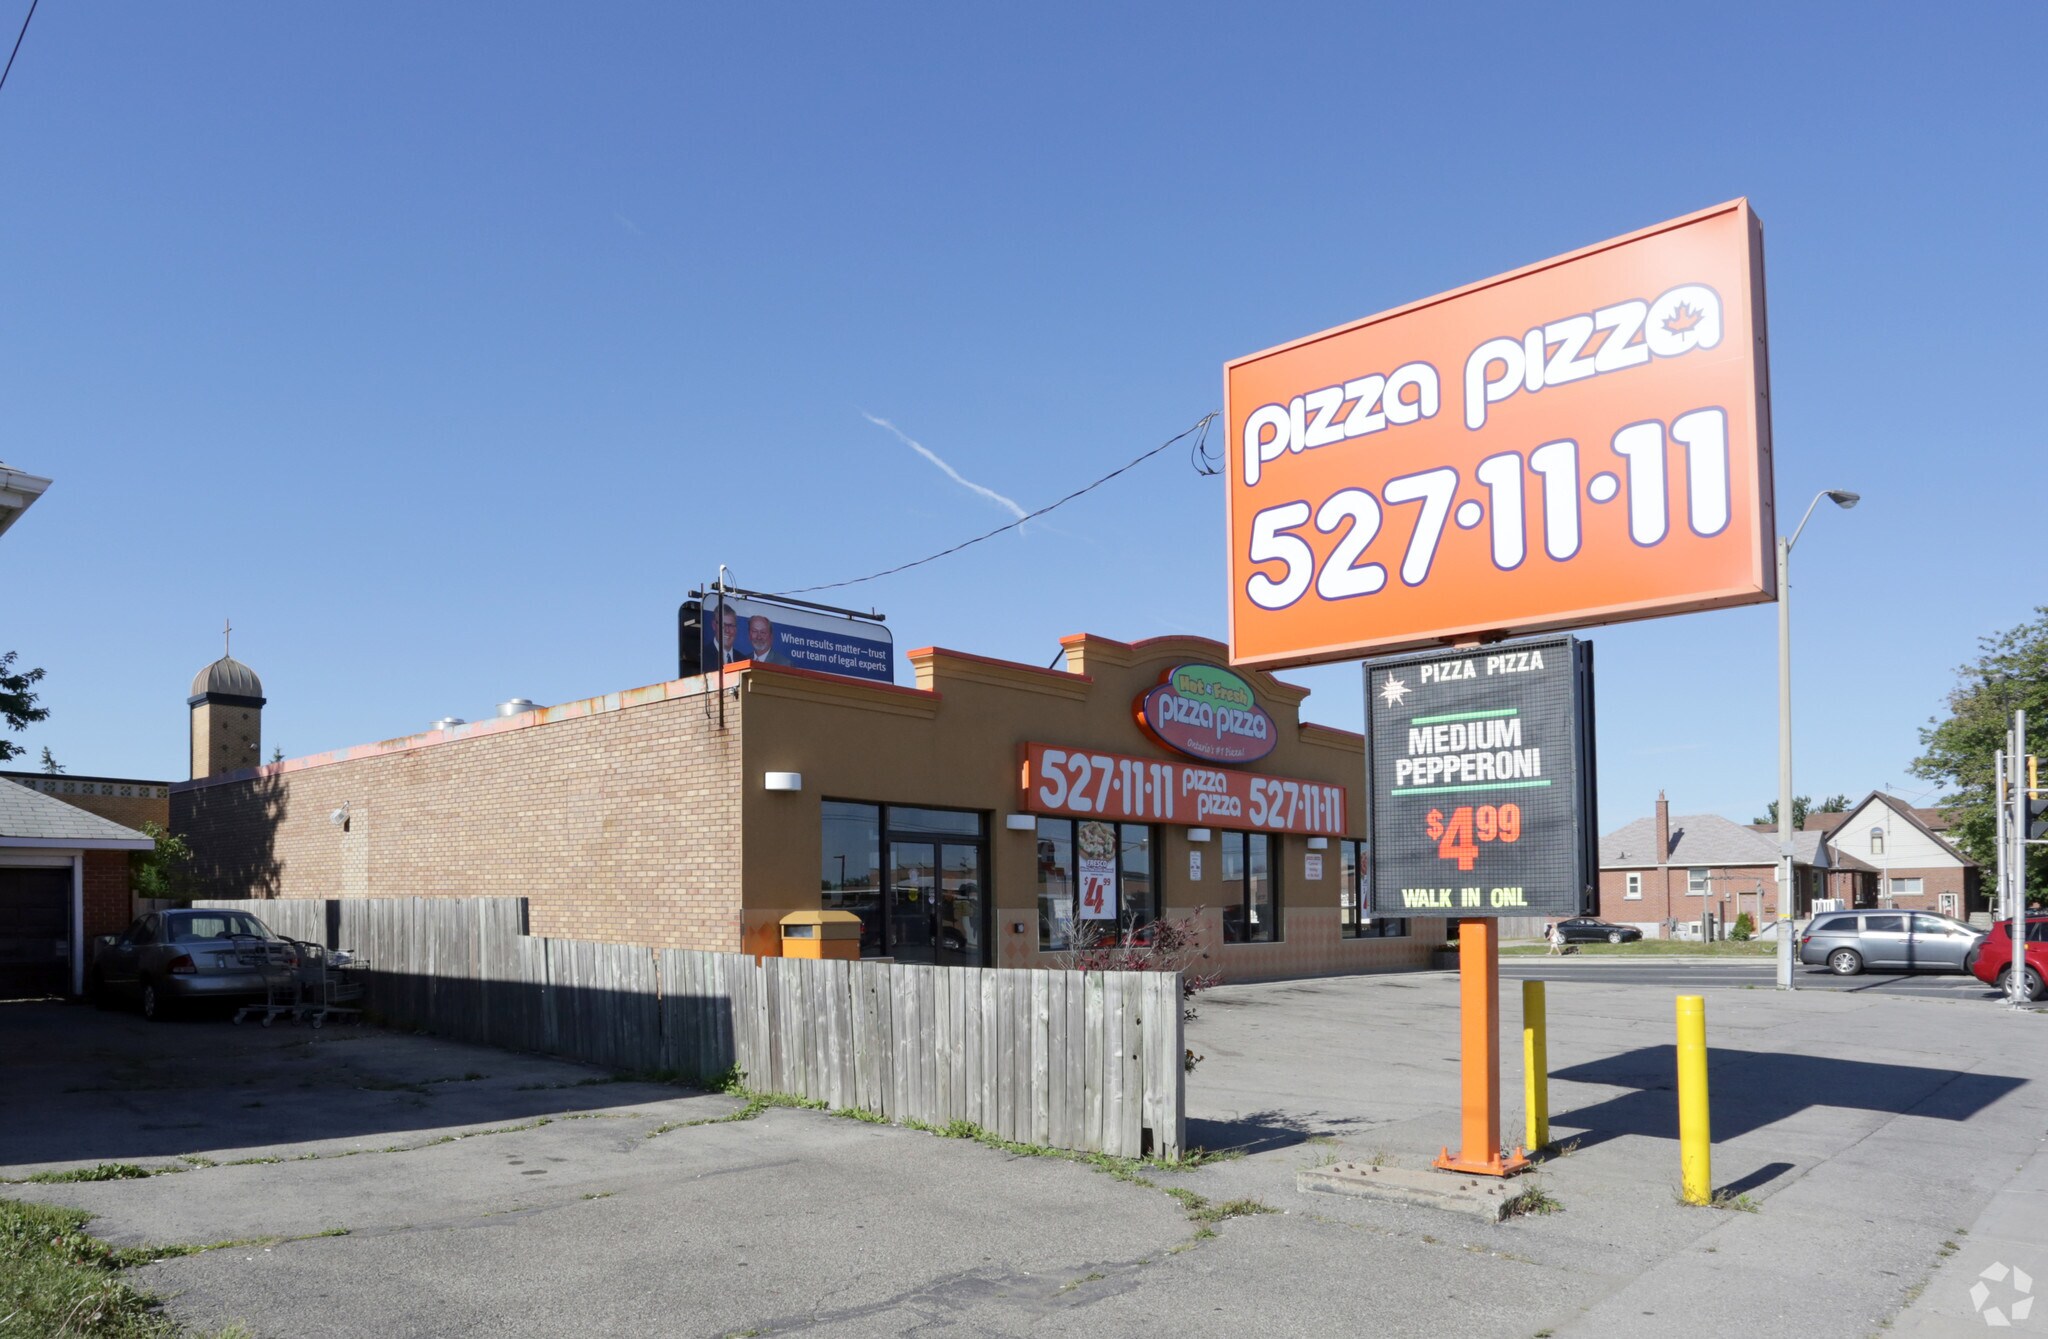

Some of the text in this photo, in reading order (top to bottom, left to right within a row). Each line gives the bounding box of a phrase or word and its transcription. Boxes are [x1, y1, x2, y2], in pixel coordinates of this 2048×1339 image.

[1244, 283, 1722, 487] pizza pizza
[781, 632, 805, 646] When
[807, 638, 834, 651] results
[791, 649, 886, 672] our team of legal experts
[1421, 651, 1544, 684] PIZZA PIZZA
[1179, 674, 1205, 695] Hot
[1212, 682, 1249, 706] Fresh
[1158, 693, 1267, 740] pizza pizza
[1187, 738, 1215, 755] Ontario's
[1216, 746, 1224, 756] #1
[1408, 718, 1522, 755] MEDIUM
[1396, 748, 1541, 786] PEPPERONI
[1182, 768, 1227, 797] pizza
[1197, 792, 1241, 821] pizza
[1087, 859, 1108, 868] FRESCO
[1402, 886, 1528, 908] WALK IN ONL
